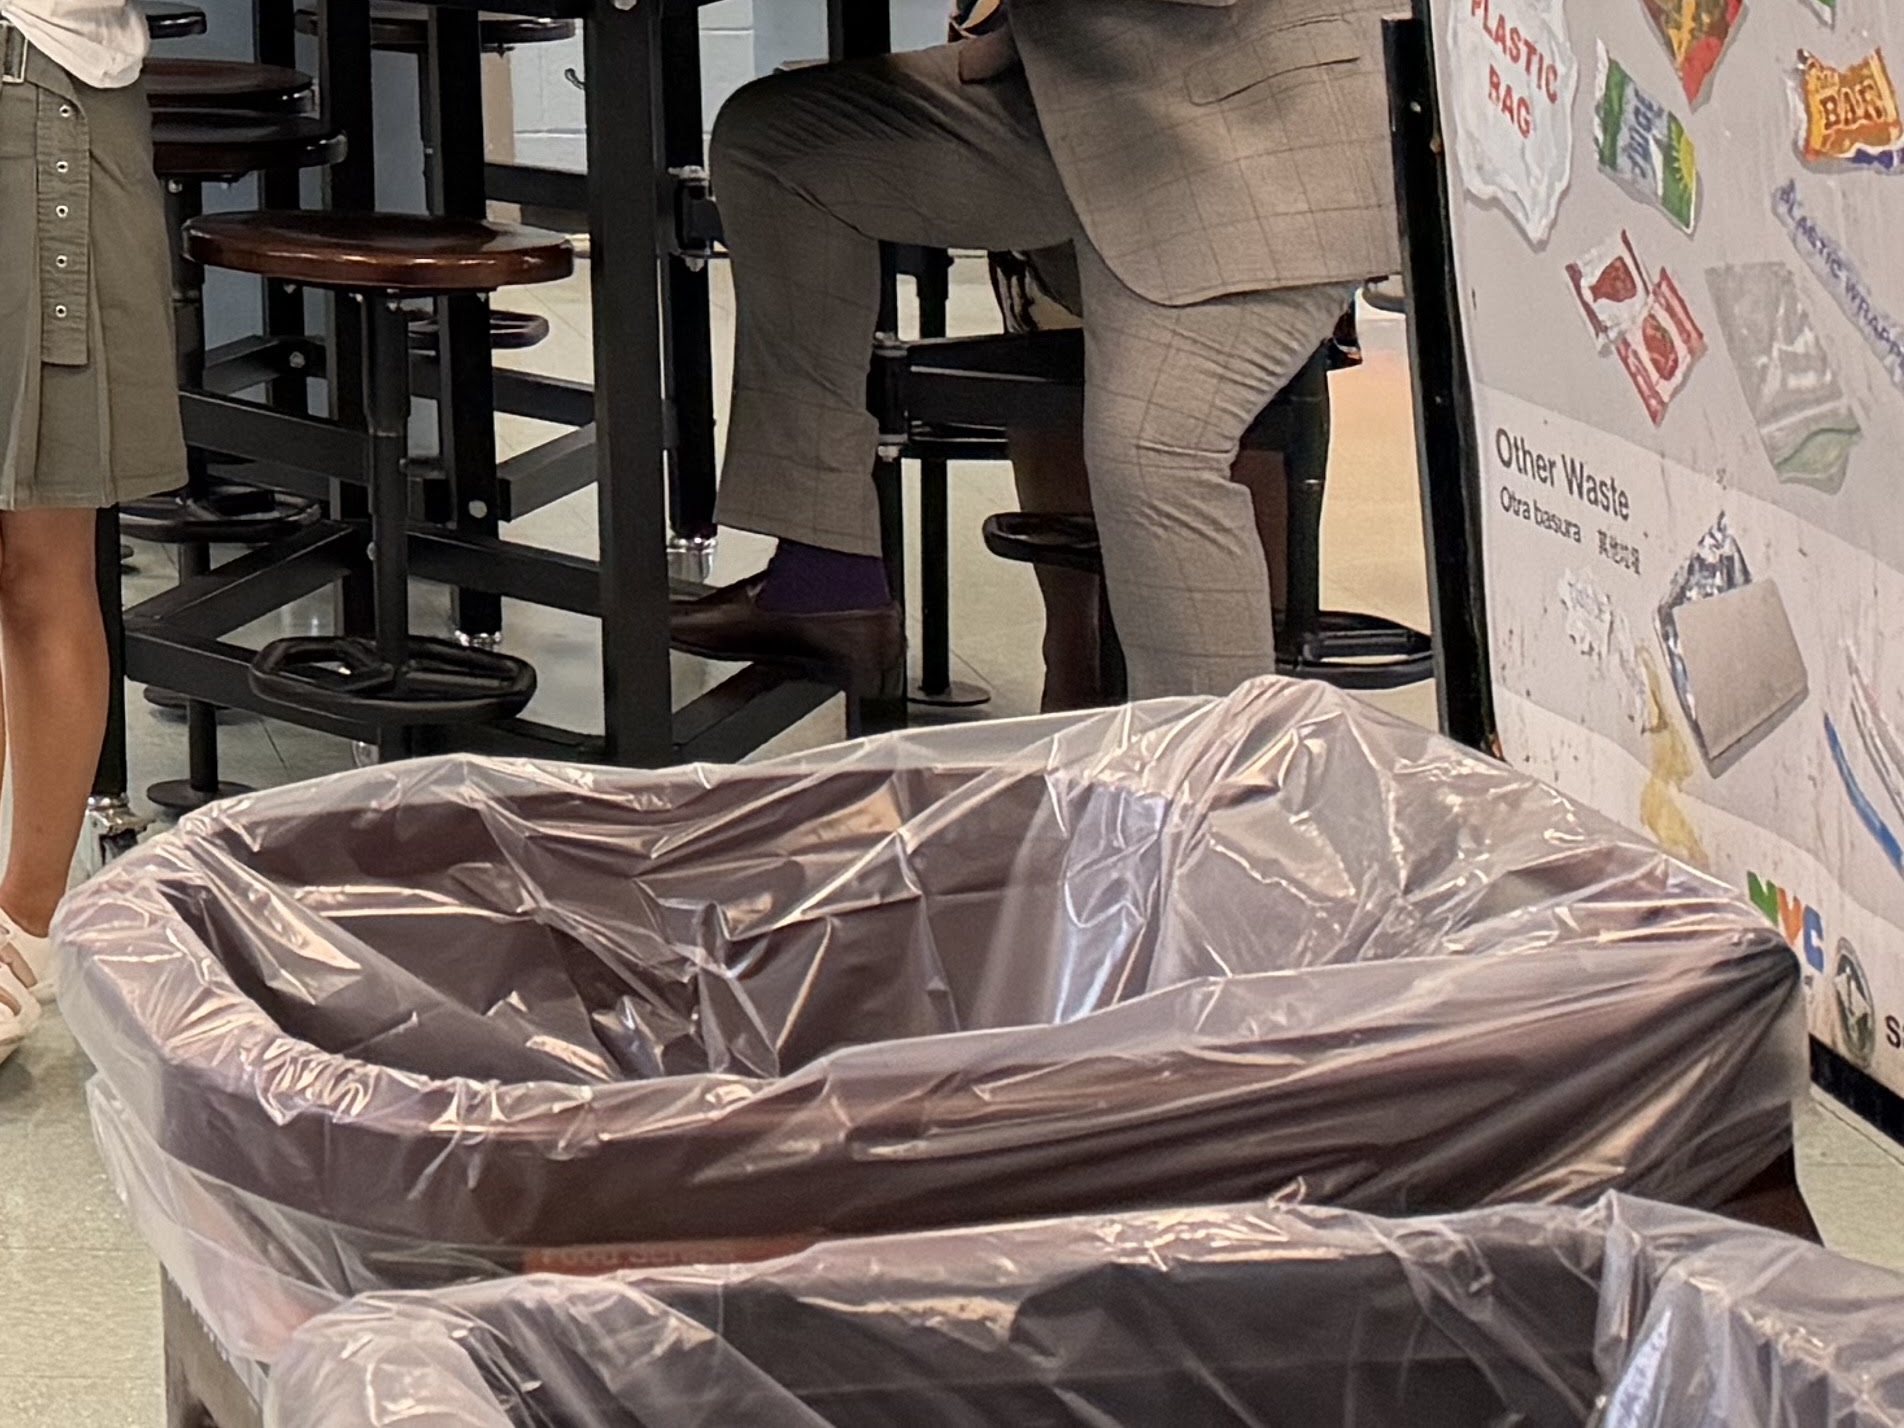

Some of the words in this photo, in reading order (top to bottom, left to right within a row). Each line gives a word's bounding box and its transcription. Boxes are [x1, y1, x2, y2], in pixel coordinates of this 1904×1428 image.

[1488, 63, 1531, 139] BAG
[1495, 427, 1557, 488] Other
[1560, 453, 1630, 522] Waste
[1500, 485, 1531, 521] Otra
[1533, 499, 1582, 544] basura
